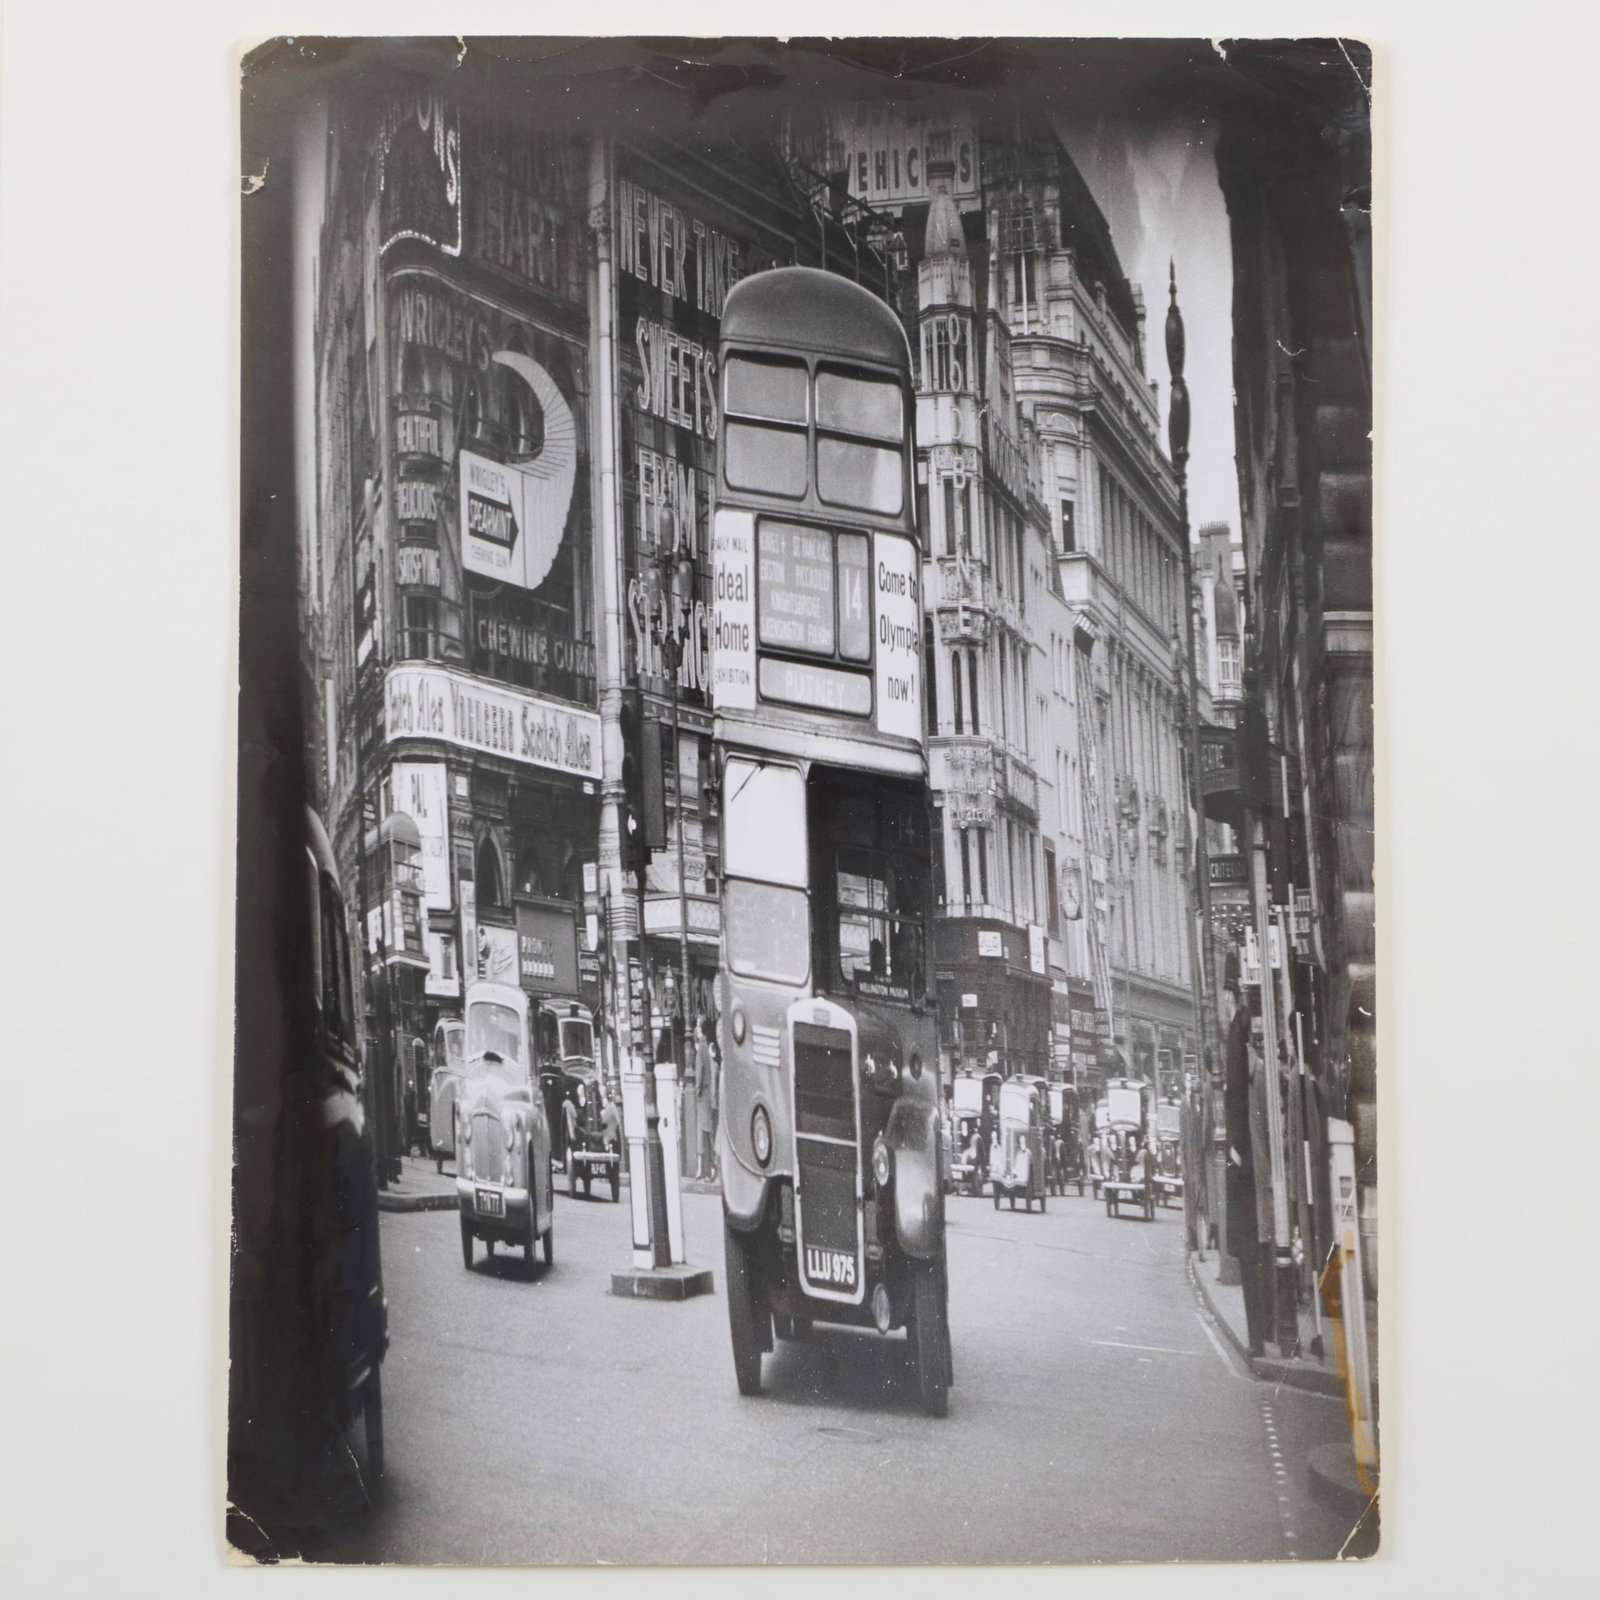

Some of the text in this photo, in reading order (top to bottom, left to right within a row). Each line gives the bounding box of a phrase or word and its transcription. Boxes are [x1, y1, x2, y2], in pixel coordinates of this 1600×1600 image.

[846, 142, 971, 191] EHICS
[620, 178, 687, 303] NEVER
[636, 316, 717, 440] SWEETS
[639, 448, 697, 559] FROM
[714, 562, 748, 602] Ideal
[845, 567, 863, 620] 14
[879, 561, 906, 596] Come
[478, 618, 548, 665] CHEWING
[714, 611, 749, 652] Home
[880, 614, 919, 657] Olympia
[785, 669, 845, 709] PUTNEY
[807, 1249, 855, 1285] LLU 975
